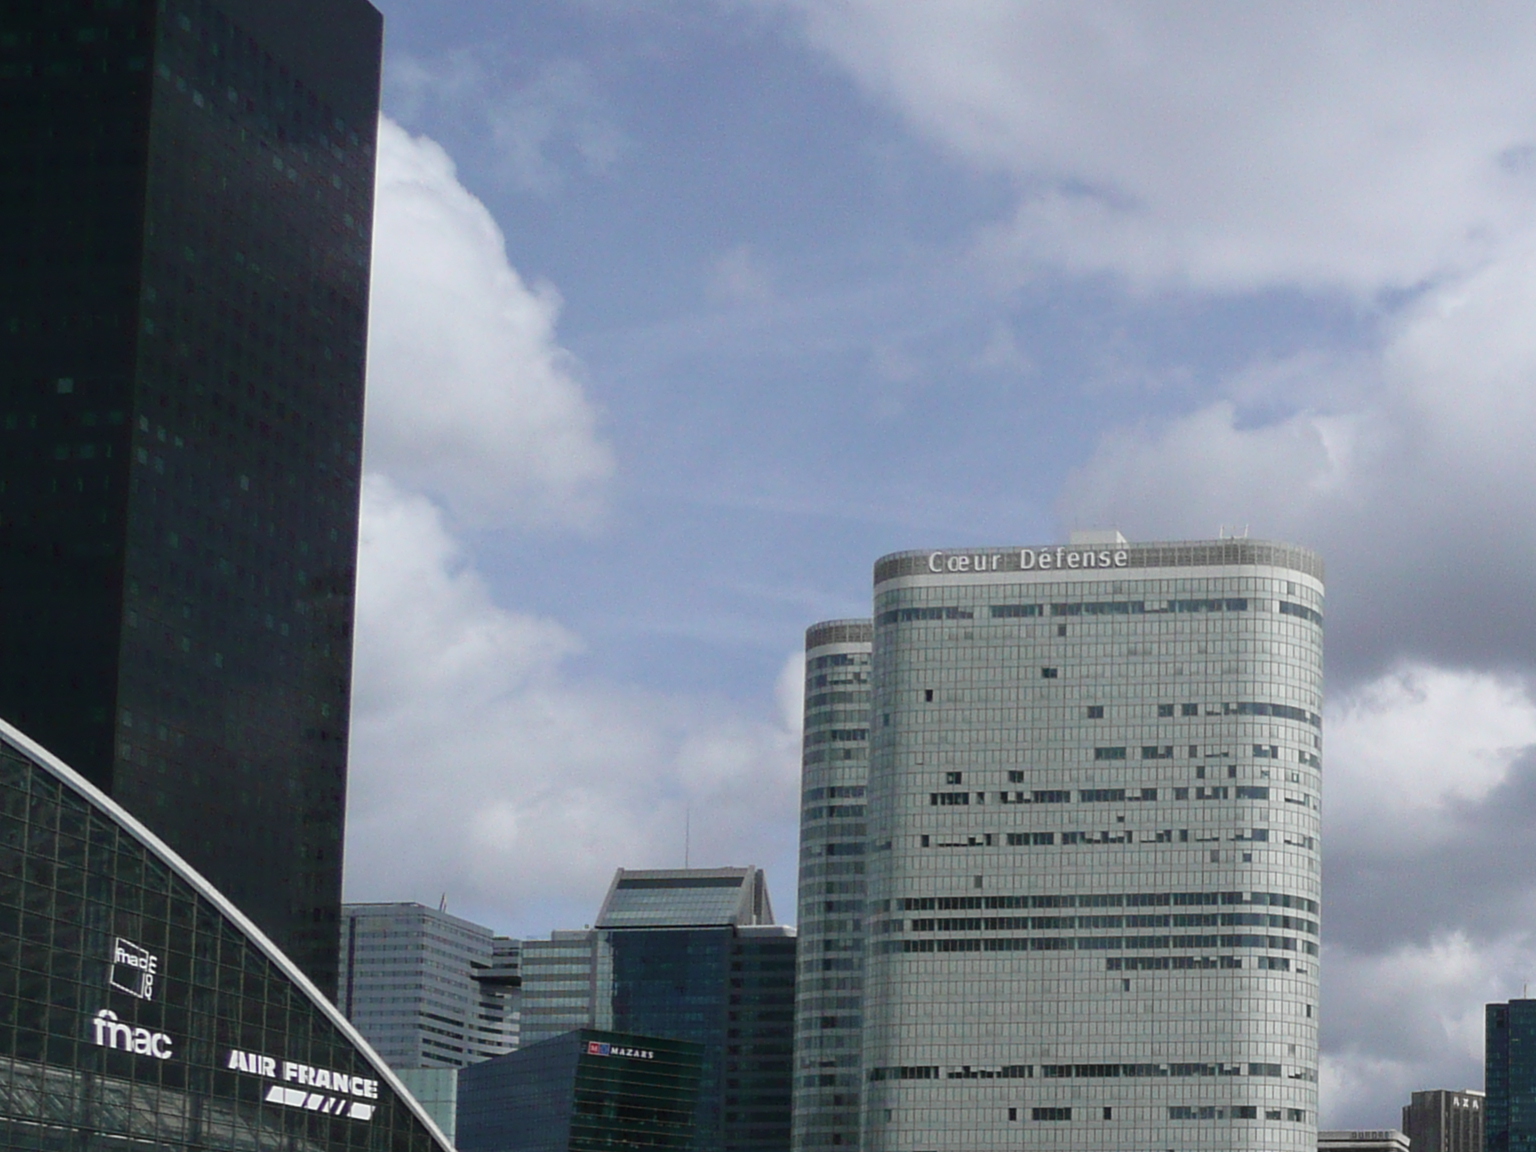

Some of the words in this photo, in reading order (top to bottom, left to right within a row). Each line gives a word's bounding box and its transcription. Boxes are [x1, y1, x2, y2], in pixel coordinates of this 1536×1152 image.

[928, 551, 1000, 573] Cœur
[1020, 547, 1128, 570] Défense
[93, 1009, 173, 1060] fnac
[610, 1046, 654, 1060] MAZARS
[228, 1049, 276, 1078] AIR
[282, 1060, 379, 1099] FRANCE
